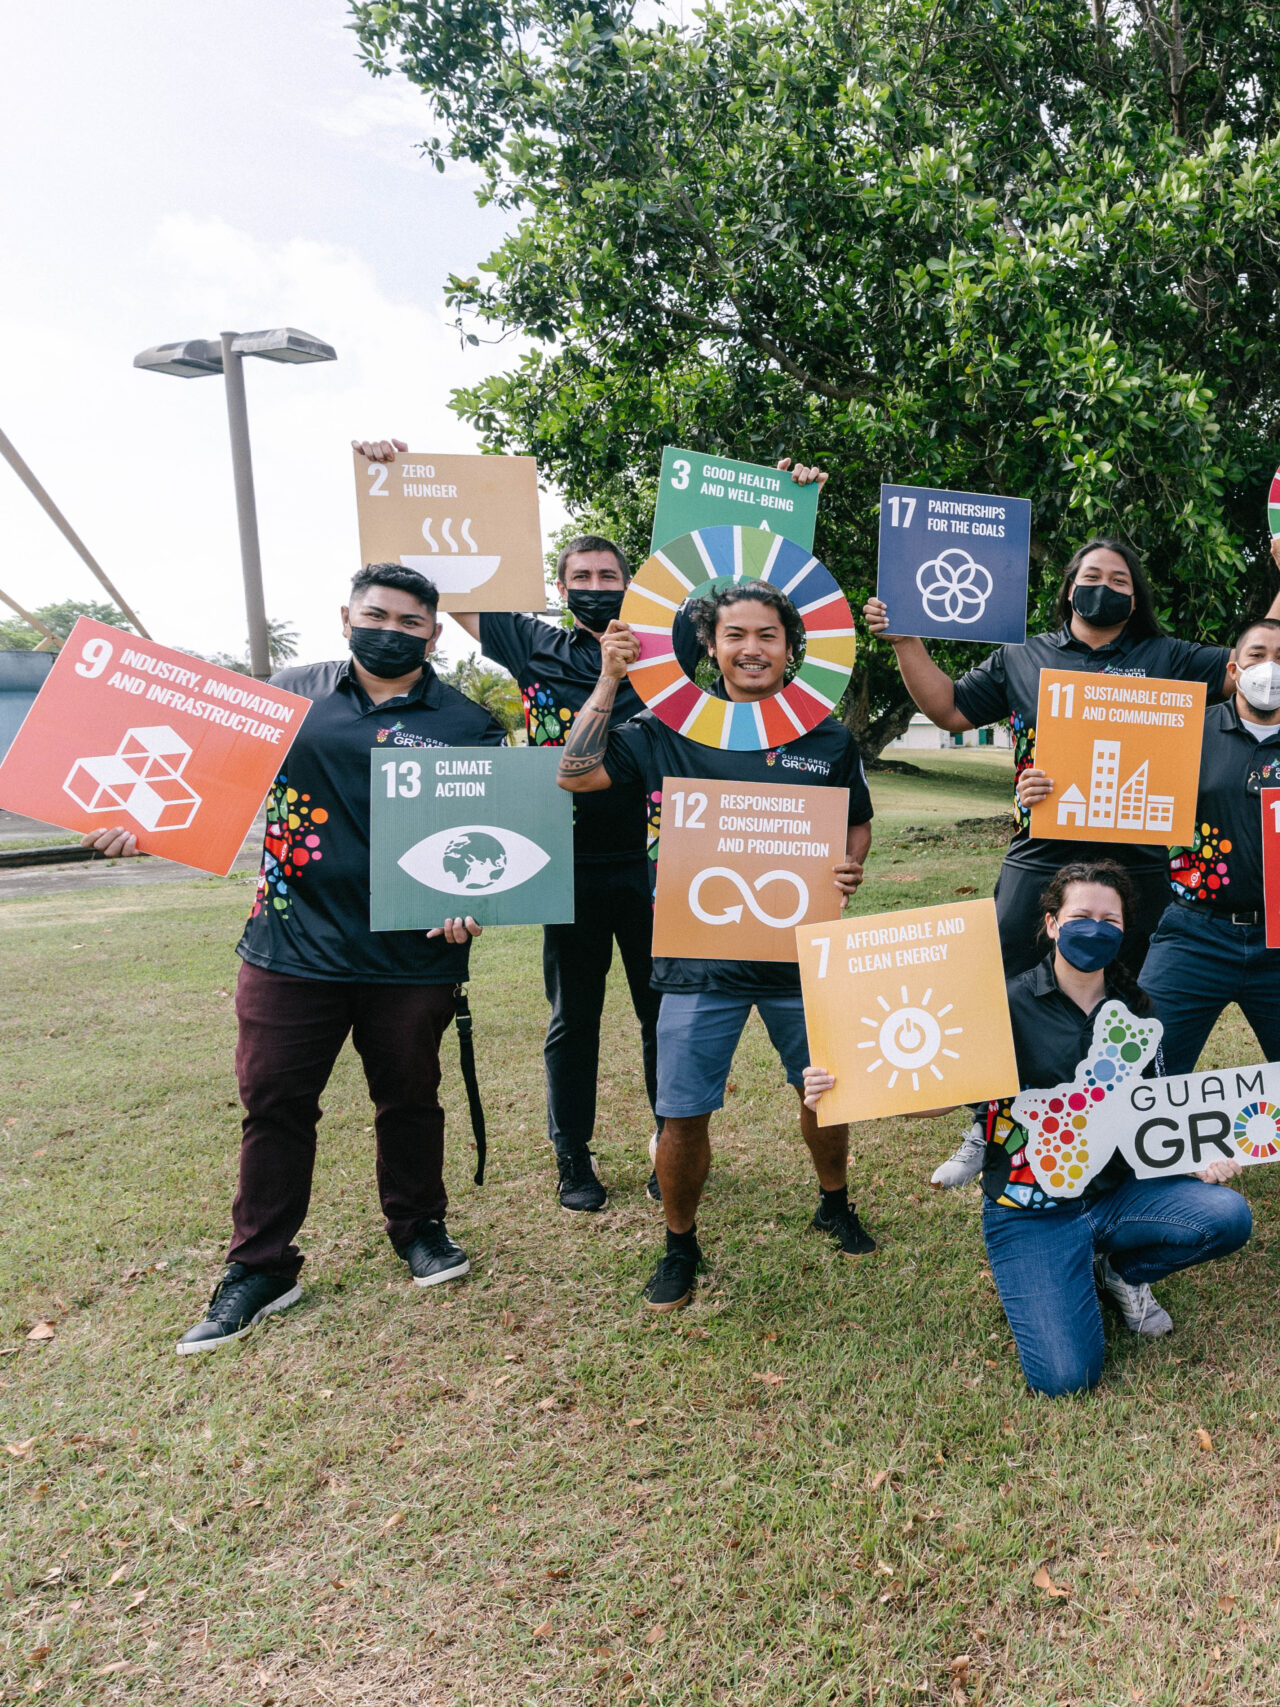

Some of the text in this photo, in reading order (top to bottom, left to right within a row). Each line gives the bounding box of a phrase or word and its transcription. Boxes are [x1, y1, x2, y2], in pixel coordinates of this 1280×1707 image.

[368, 463, 389, 496] 2
[402, 464, 435, 478] ZERO
[671, 460, 691, 490] 3
[703, 465, 780, 491] GOOD HEALTH
[403, 484, 458, 498] HUNGER
[700, 482, 793, 512] AND WELL-BEING
[888, 496, 916, 528] 17
[929, 500, 1005, 519] PARTNERSHIPS
[928, 518, 1005, 537] FOR THE GOALS
[75, 638, 113, 678] 9
[120, 649, 294, 723] INDUSTRY, INNOVATION
[1084, 685, 1192, 708] SUSTAINABLE CITIES
[107, 671, 284, 744] AND INFRASTRUCTURE
[1048, 683, 1074, 718] 11
[1082, 706, 1184, 727] AND COMMUNITIES
[396, 731, 422, 740] GUAM
[381, 761, 421, 798] 13
[436, 760, 492, 775] CLIMATE
[782, 759, 830, 776] GROWTH
[435, 782, 485, 797] ACTION
[671, 791, 708, 829] 12
[721, 794, 805, 813] RESPONSIBLE
[719, 816, 811, 835] CONSUMPTION
[717, 837, 829, 857] AND PRODUCTION
[846, 917, 965, 950] AFFORDABLE AND
[811, 937, 831, 979] 7
[848, 944, 948, 973] CLEAN ENERGY
[1131, 1071, 1264, 1111] GUAM
